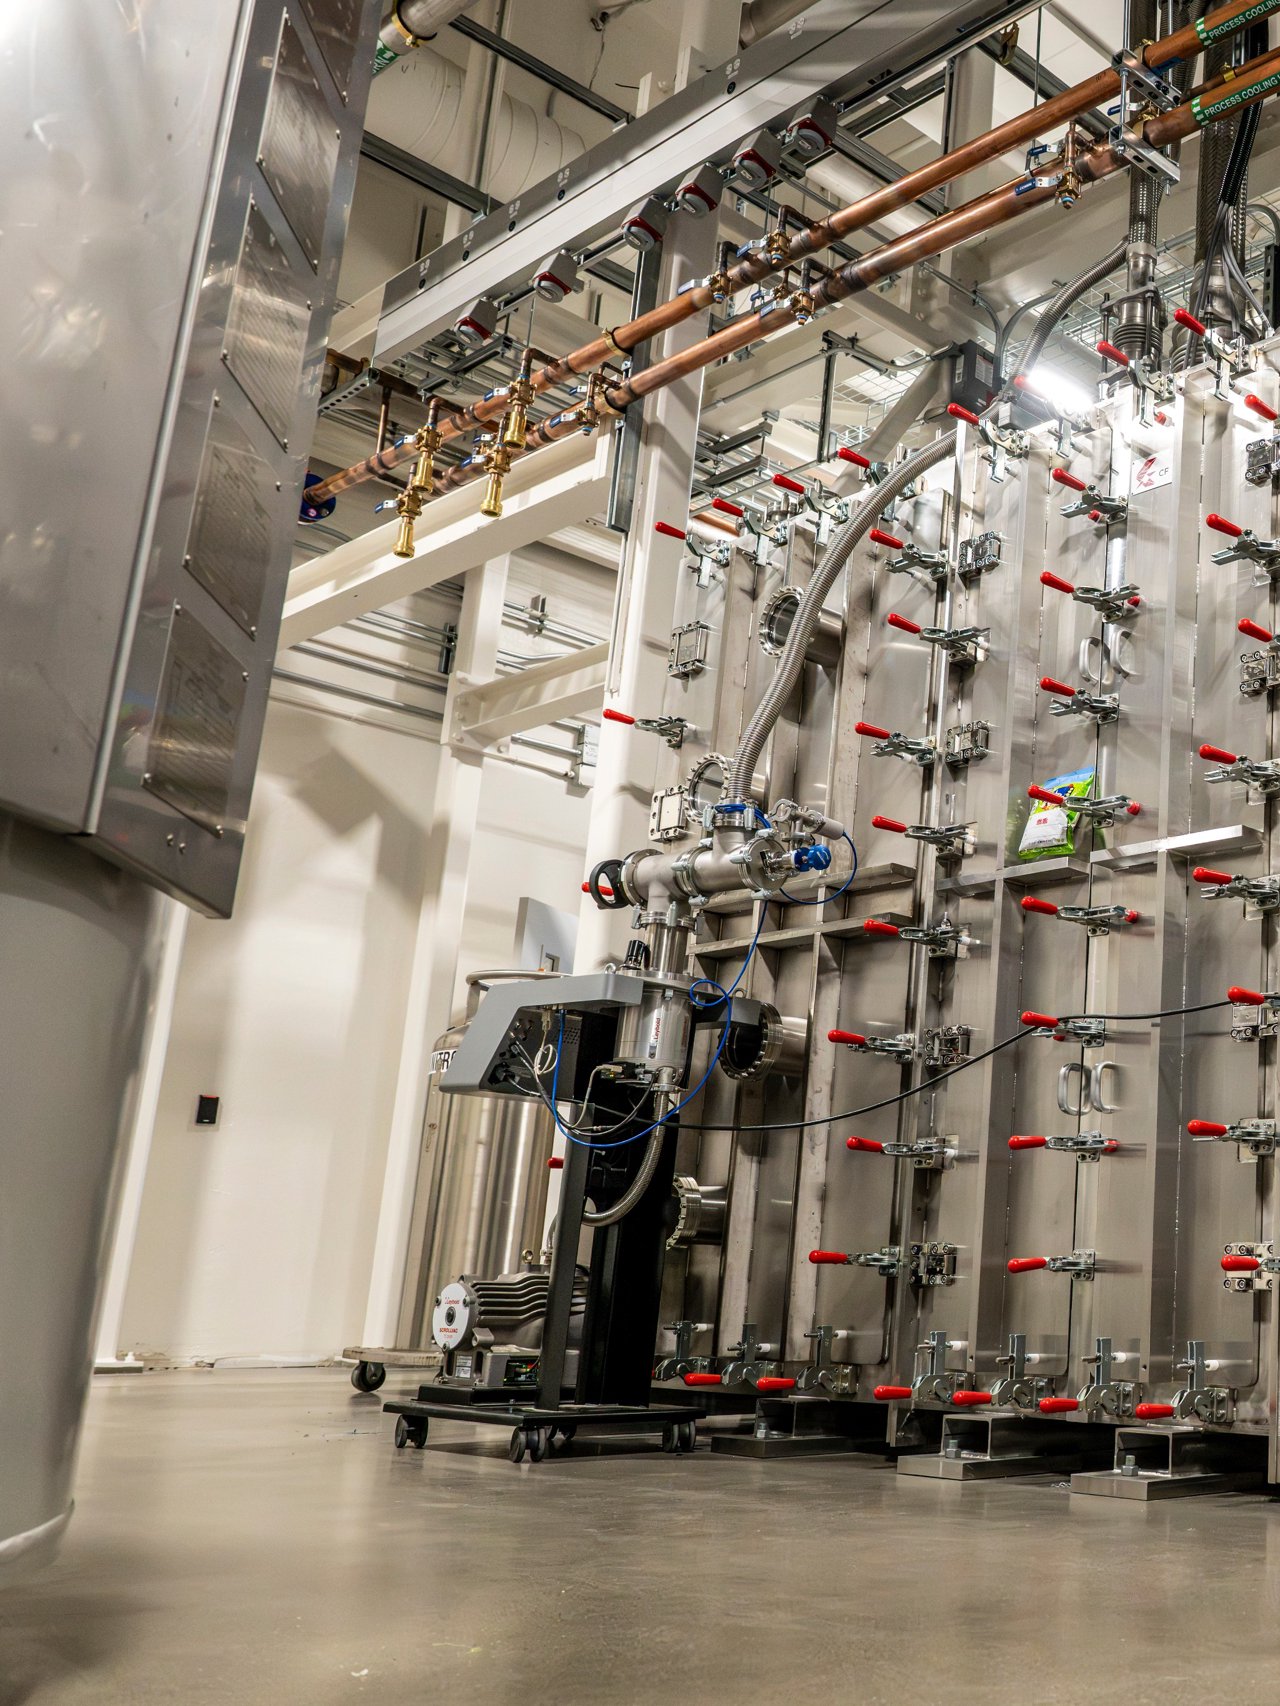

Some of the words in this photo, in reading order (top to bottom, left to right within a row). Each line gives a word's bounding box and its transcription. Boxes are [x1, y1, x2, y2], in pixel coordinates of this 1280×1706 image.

[1208, 15, 1246, 39] PROCESS
[1204, 95, 1242, 117] PROCESS
[1241, 77, 1278, 98] COOLING
